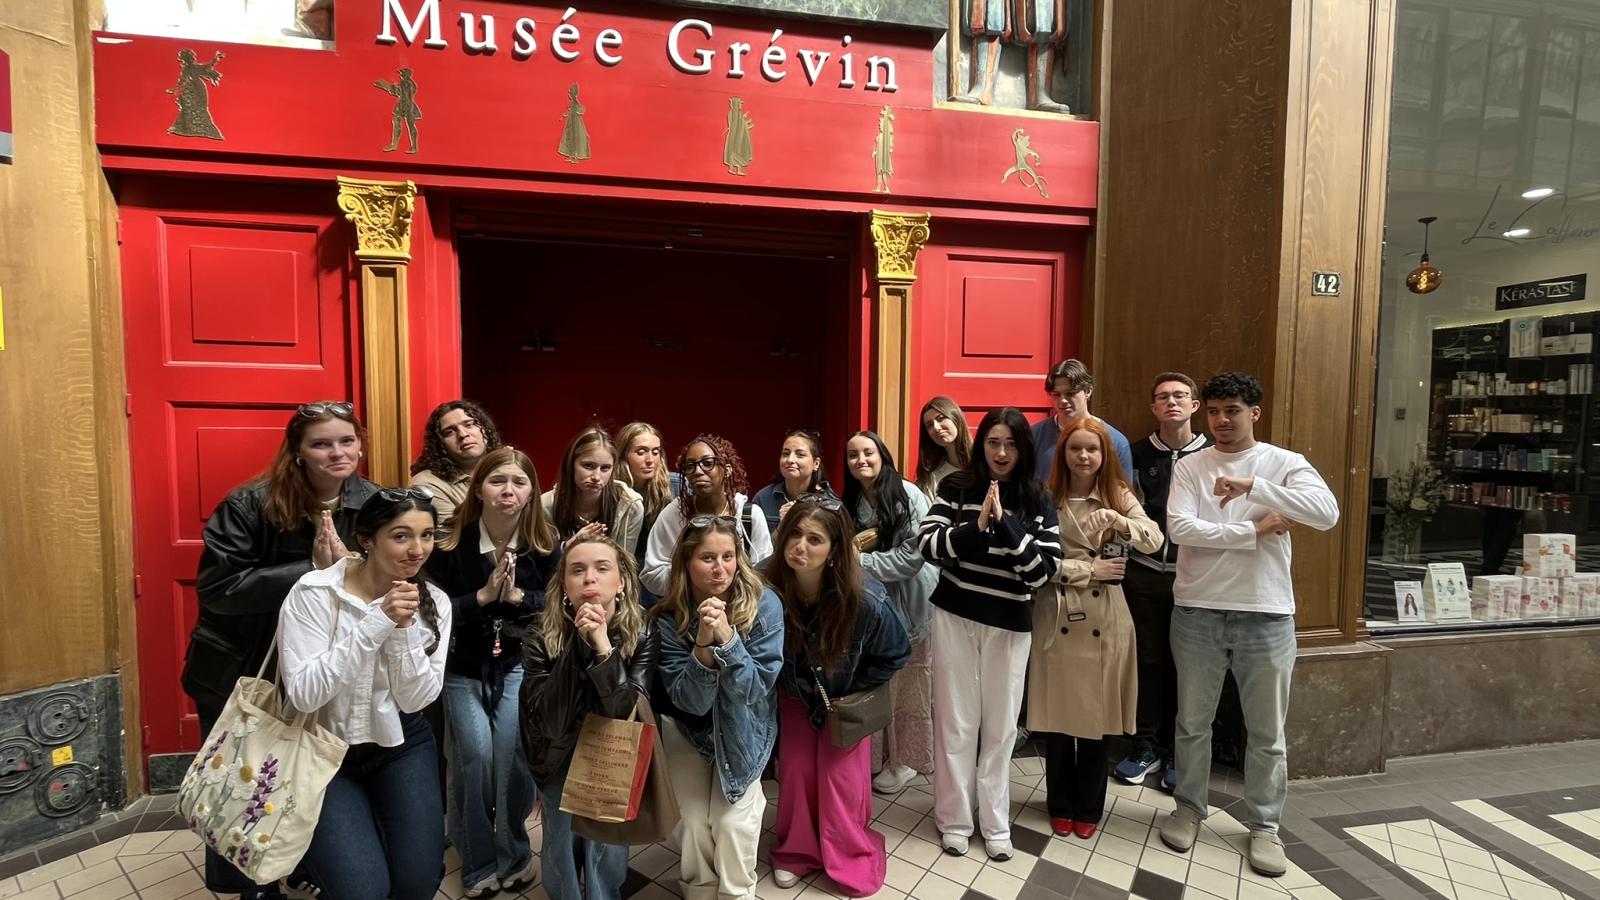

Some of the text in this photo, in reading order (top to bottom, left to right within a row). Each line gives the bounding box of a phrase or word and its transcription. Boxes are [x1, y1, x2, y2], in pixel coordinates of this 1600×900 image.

[376, 0, 898, 92] Musée Grévin
[1316, 274, 1338, 294] 42
